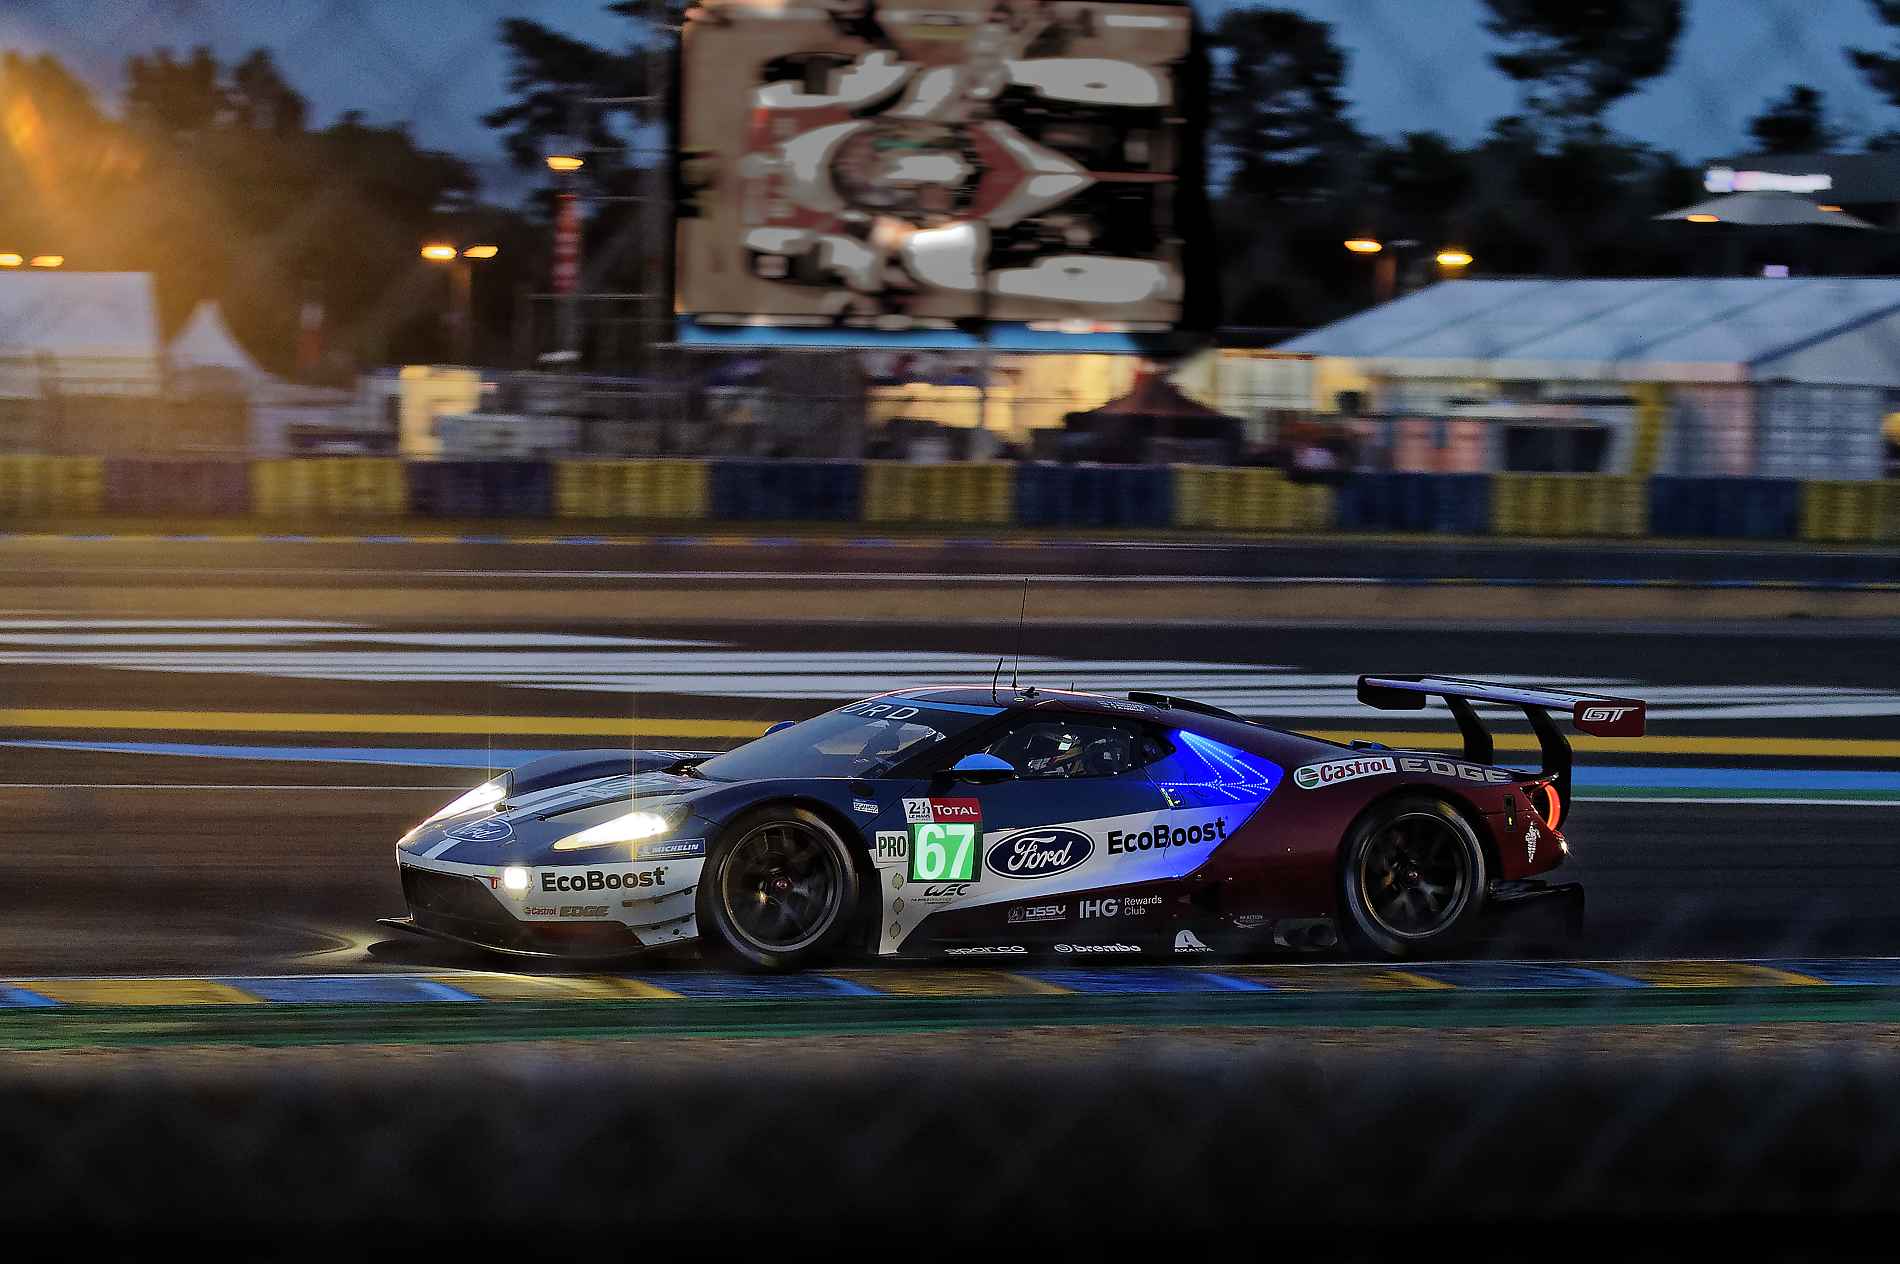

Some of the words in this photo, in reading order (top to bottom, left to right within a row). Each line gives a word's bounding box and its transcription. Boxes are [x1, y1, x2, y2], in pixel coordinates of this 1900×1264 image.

[1581, 706, 1639, 722] GT
[1320, 758, 1391, 783] Castrol
[1400, 757, 1512, 783] EDGE
[934, 804, 979, 815] TOTAL
[1107, 817, 1227, 855] EcoBoost
[878, 835, 907, 857] PRO
[916, 824, 974, 880] 67
[1007, 835, 1071, 871] Ford
[541, 866, 666, 891] EcoBoost
[923, 883, 970, 896] WEC
[1079, 899, 1118, 918] IHG
[1124, 896, 1162, 906] Rewards
[531, 906, 557, 916] Castrol
[560, 906, 609, 917] EDGE
[1124, 907, 1146, 916] Club
[1072, 942, 1141, 952] brembo
